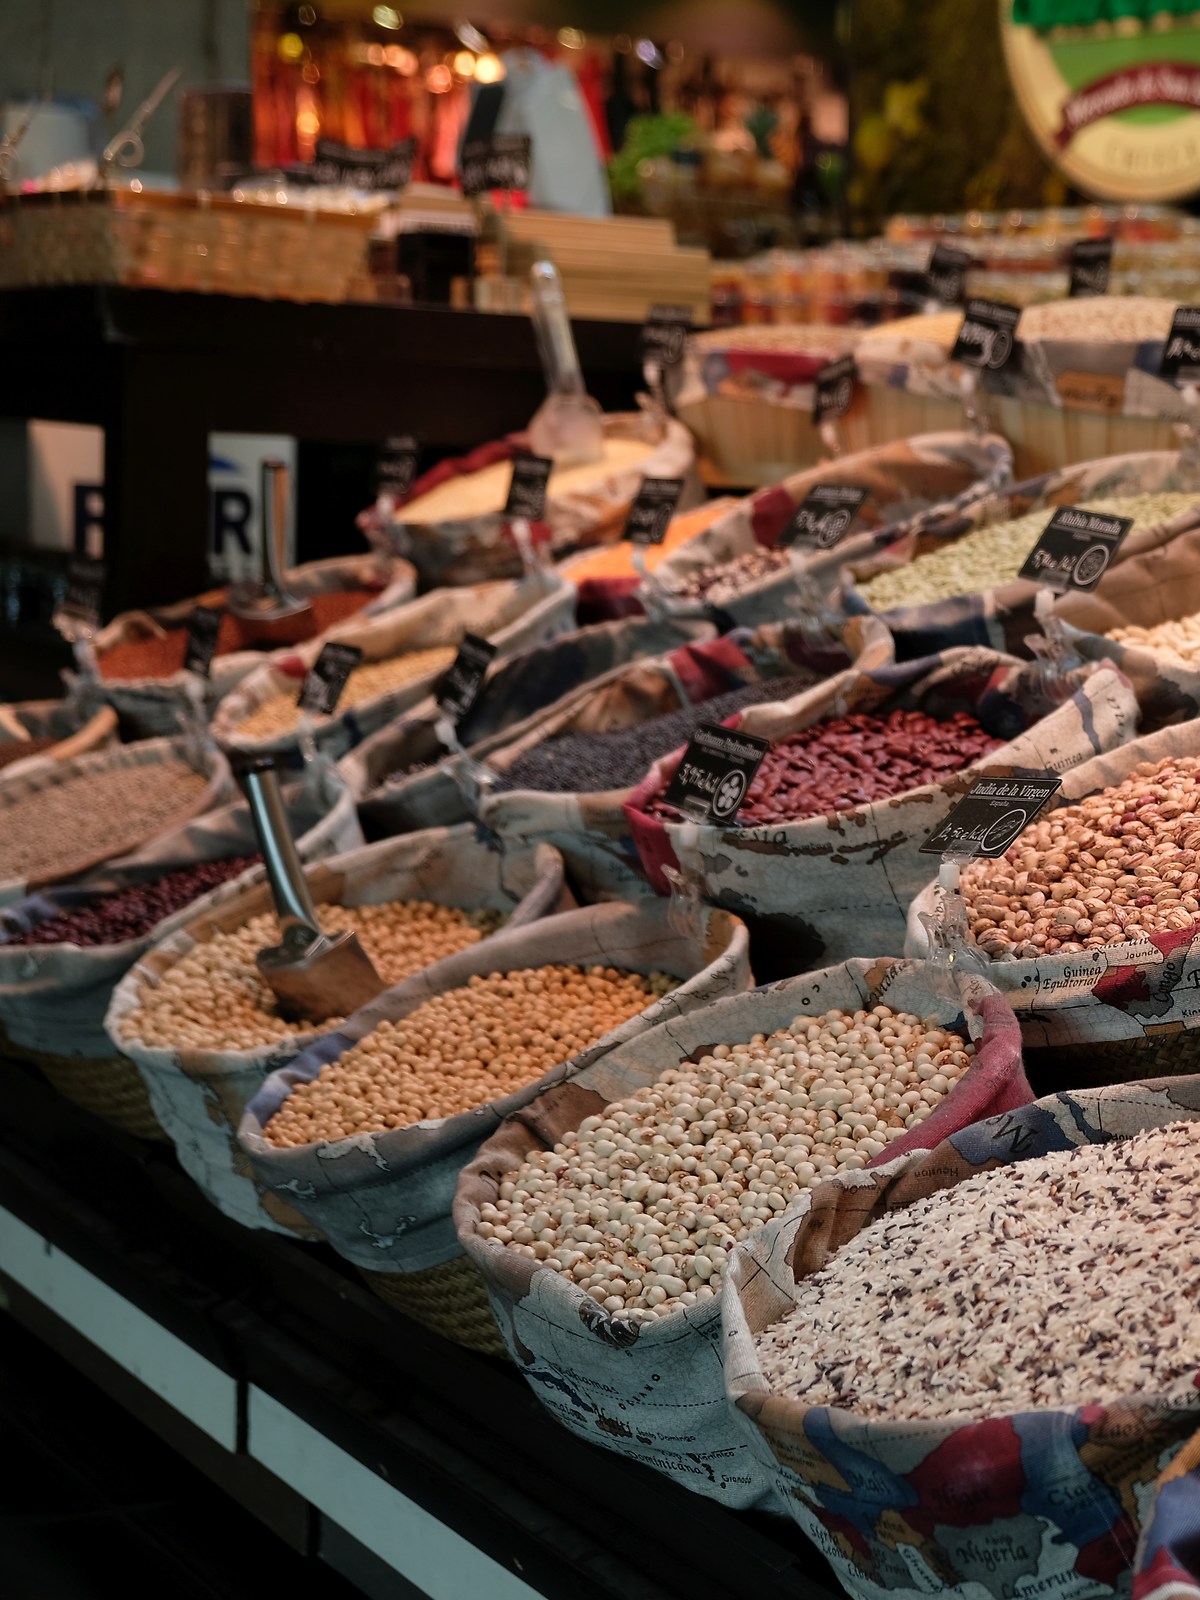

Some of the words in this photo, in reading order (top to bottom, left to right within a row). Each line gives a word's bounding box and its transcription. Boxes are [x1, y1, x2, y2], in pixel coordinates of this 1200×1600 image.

[970, 783, 995, 796] Judía
[996, 783, 1008, 796] de
[1008, 784, 1018, 796] la
[1019, 785, 1049, 800] Virgen
[1063, 965, 1102, 980] Guinea
[1042, 975, 1100, 992] Equatorial
[955, 1540, 1032, 1574] Nigeria
